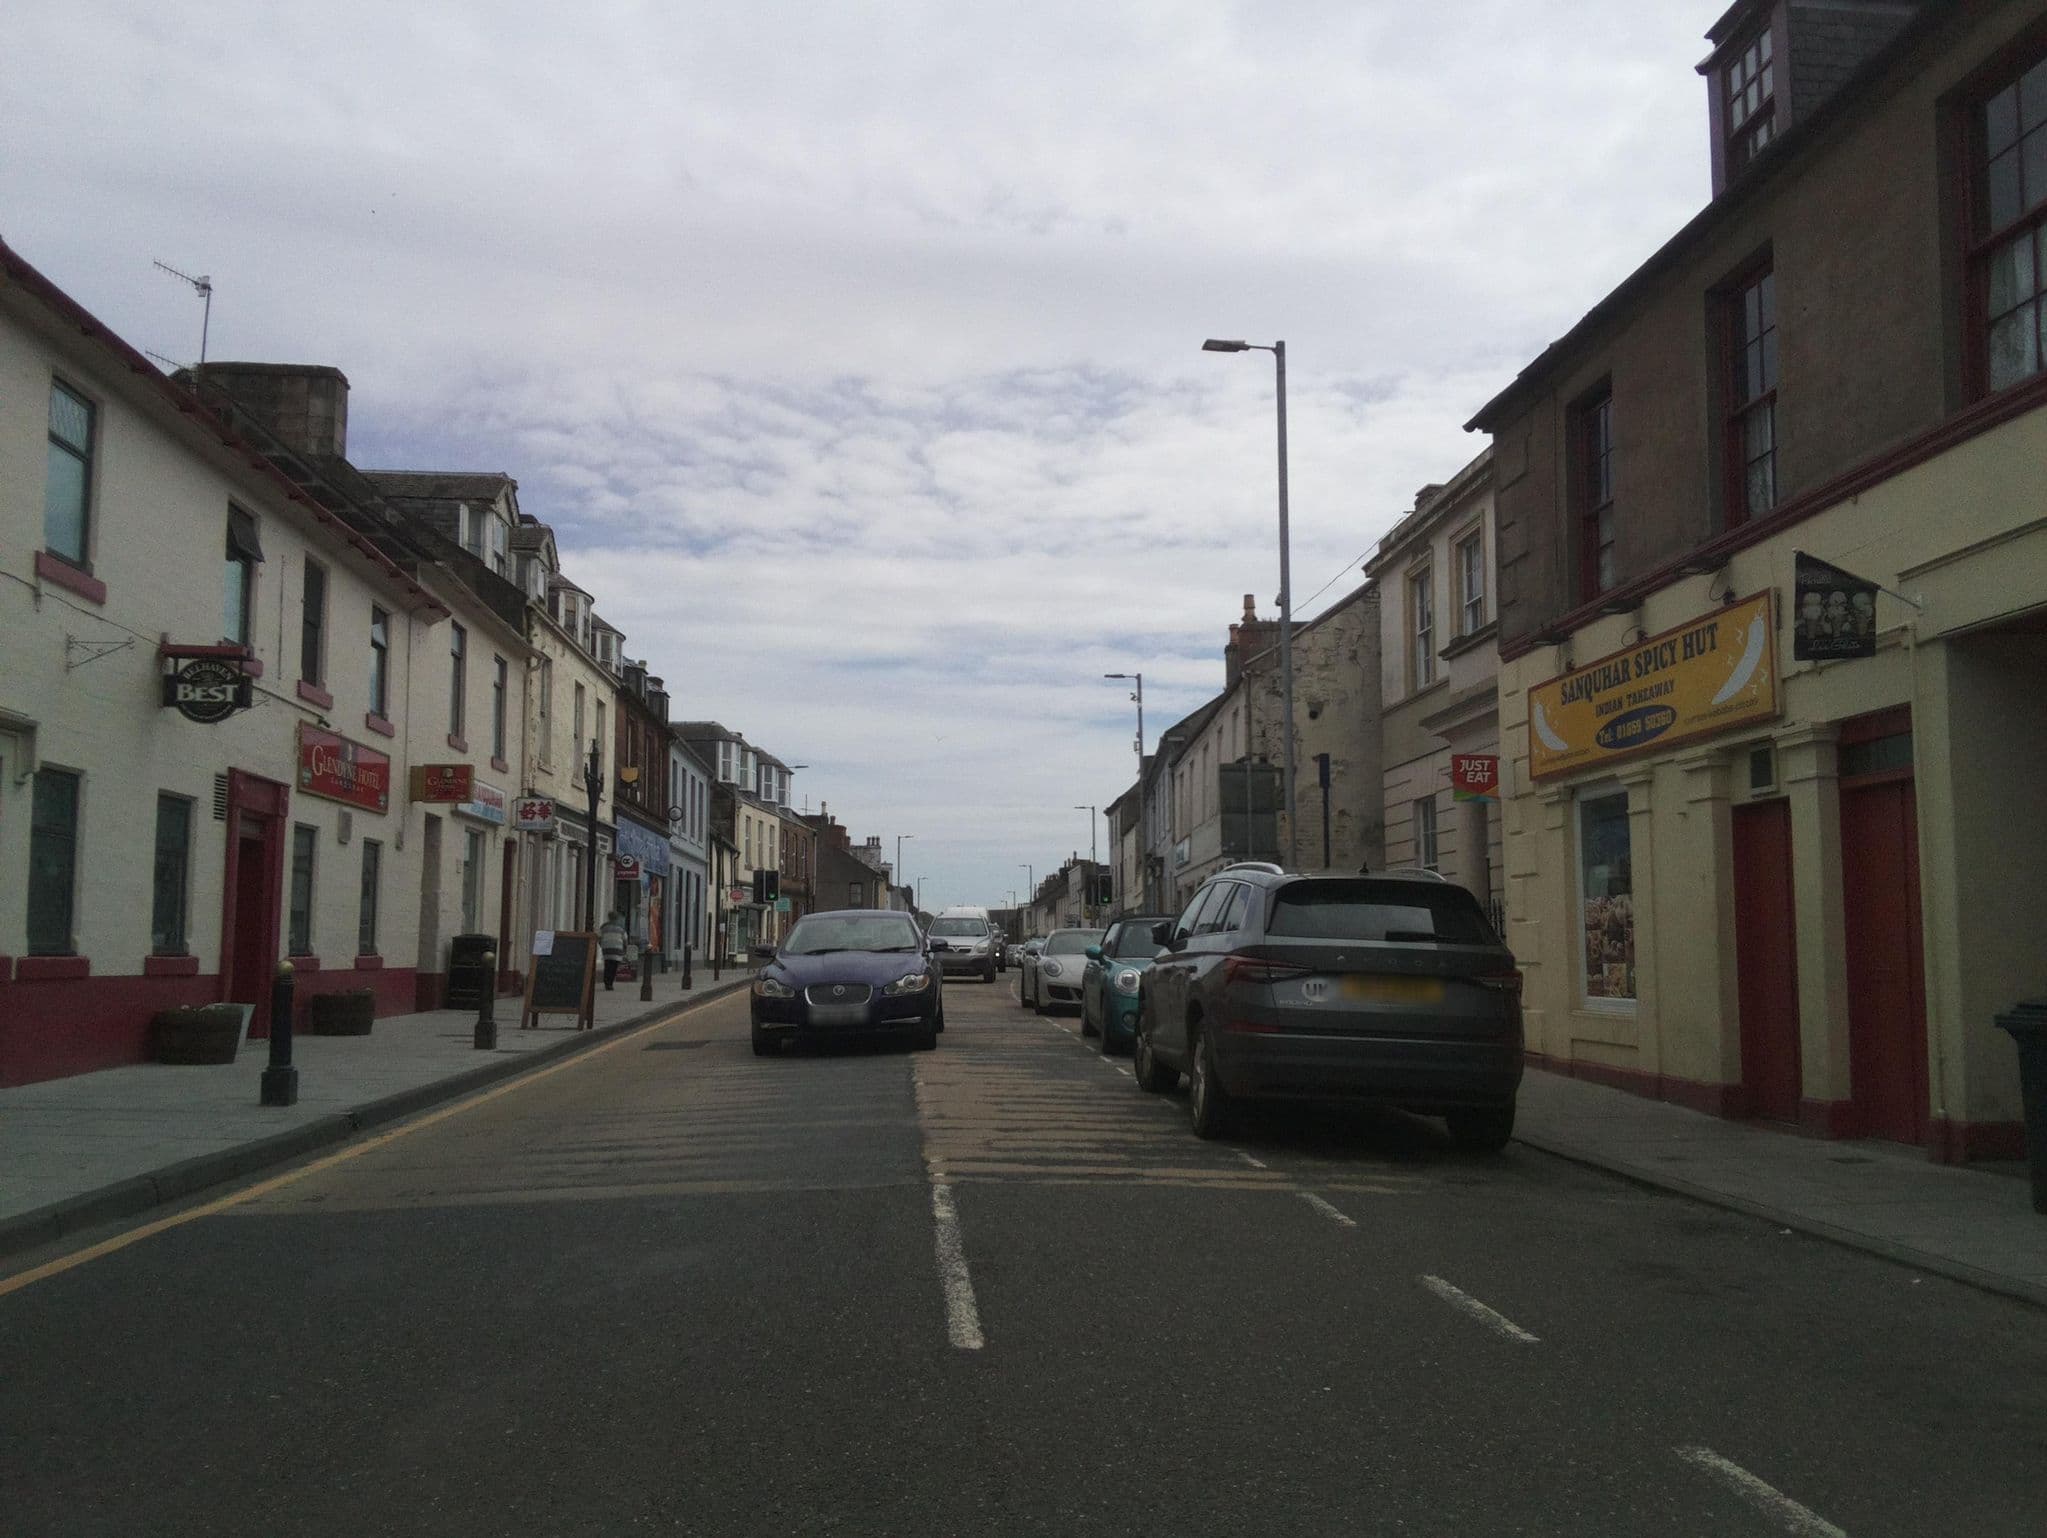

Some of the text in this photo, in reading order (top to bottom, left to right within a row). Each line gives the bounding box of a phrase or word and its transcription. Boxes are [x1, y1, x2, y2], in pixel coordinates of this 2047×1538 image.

[1560, 622, 1719, 706] SANQUHAR SPICY HUT
[176, 684, 239, 702] BEST
[1595, 679, 1675, 718] INDIAN TAKEAWAY
[1459, 759, 1492, 773] JUST
[358, 767, 382, 791] HOTEL
[1466, 772, 1492, 783] EAT
